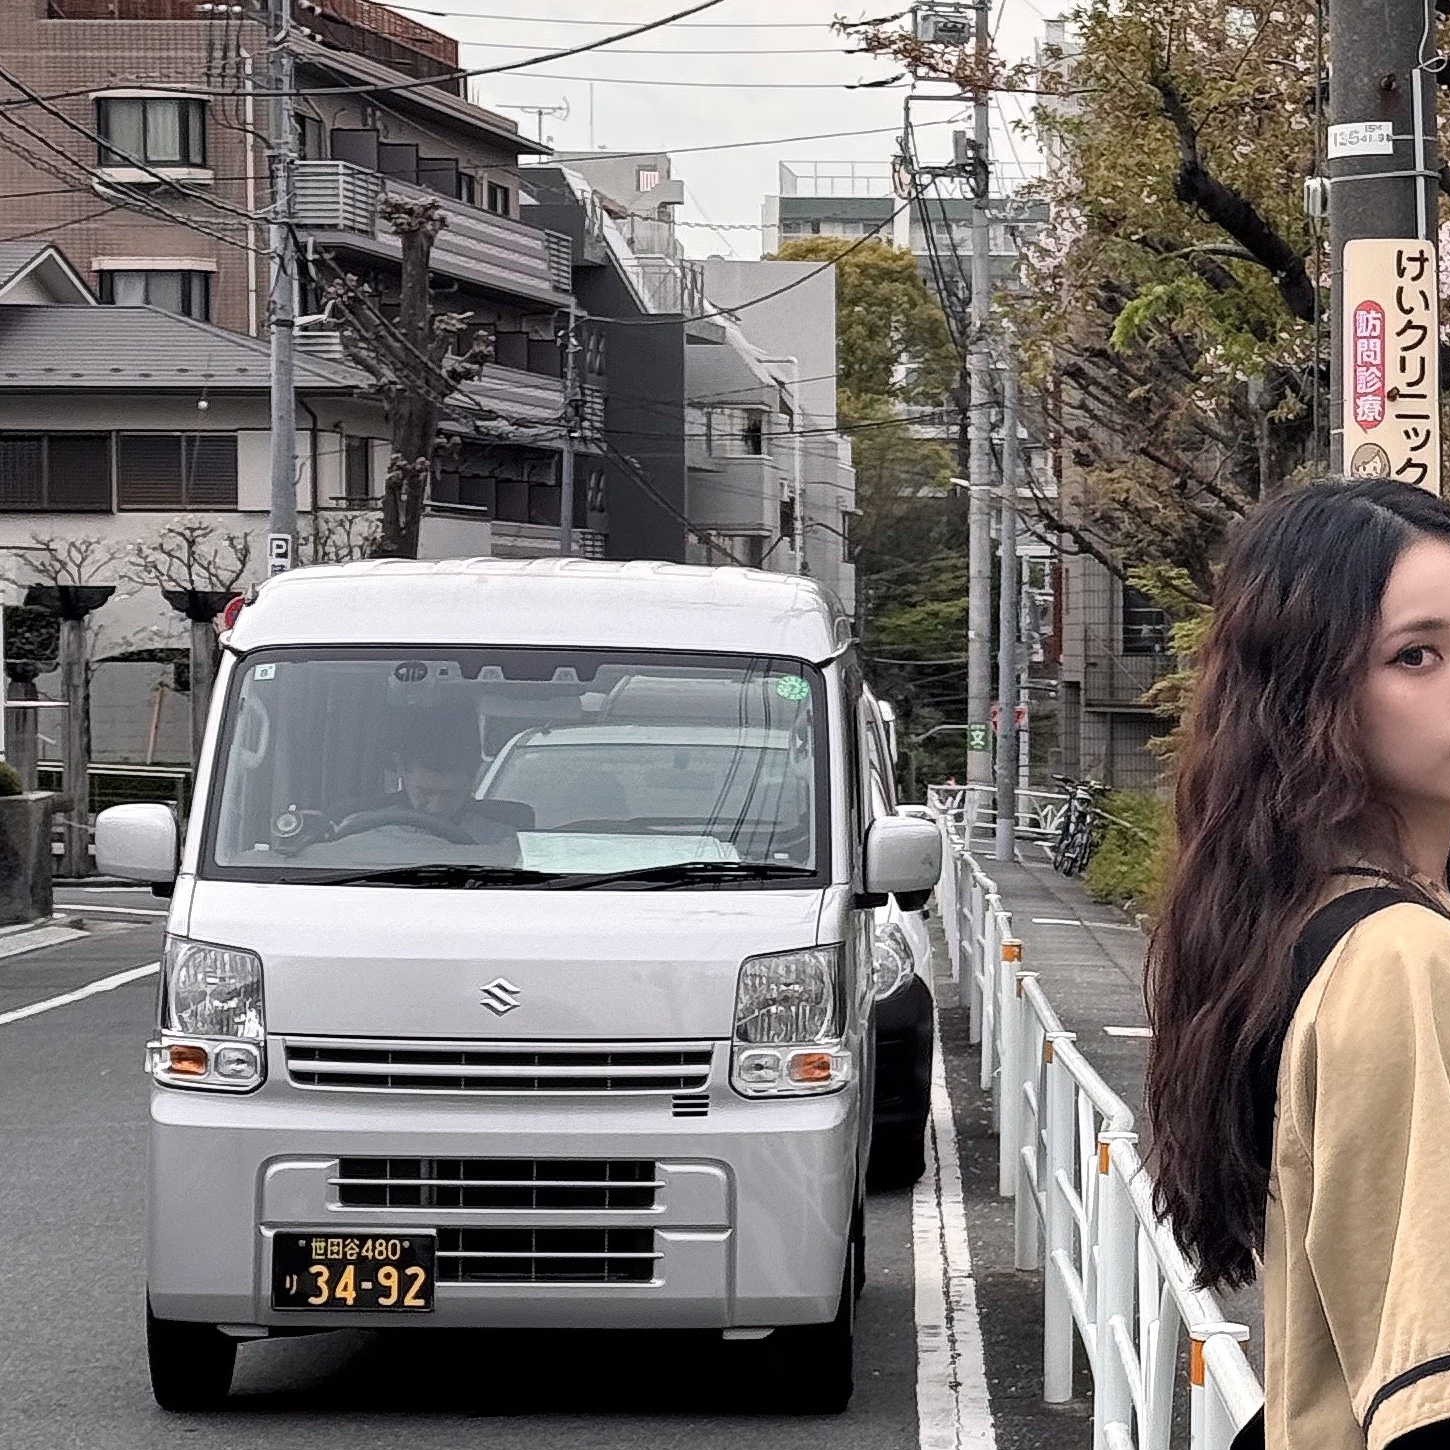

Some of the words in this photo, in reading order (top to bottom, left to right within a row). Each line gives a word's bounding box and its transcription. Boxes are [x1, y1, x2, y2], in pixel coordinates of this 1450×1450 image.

[1356, 310, 1383, 421] 訪問診療
[1395, 248, 1430, 484] けいクリニック
[272, 540, 287, 558] P
[307, 1264, 426, 1306] 34-92
